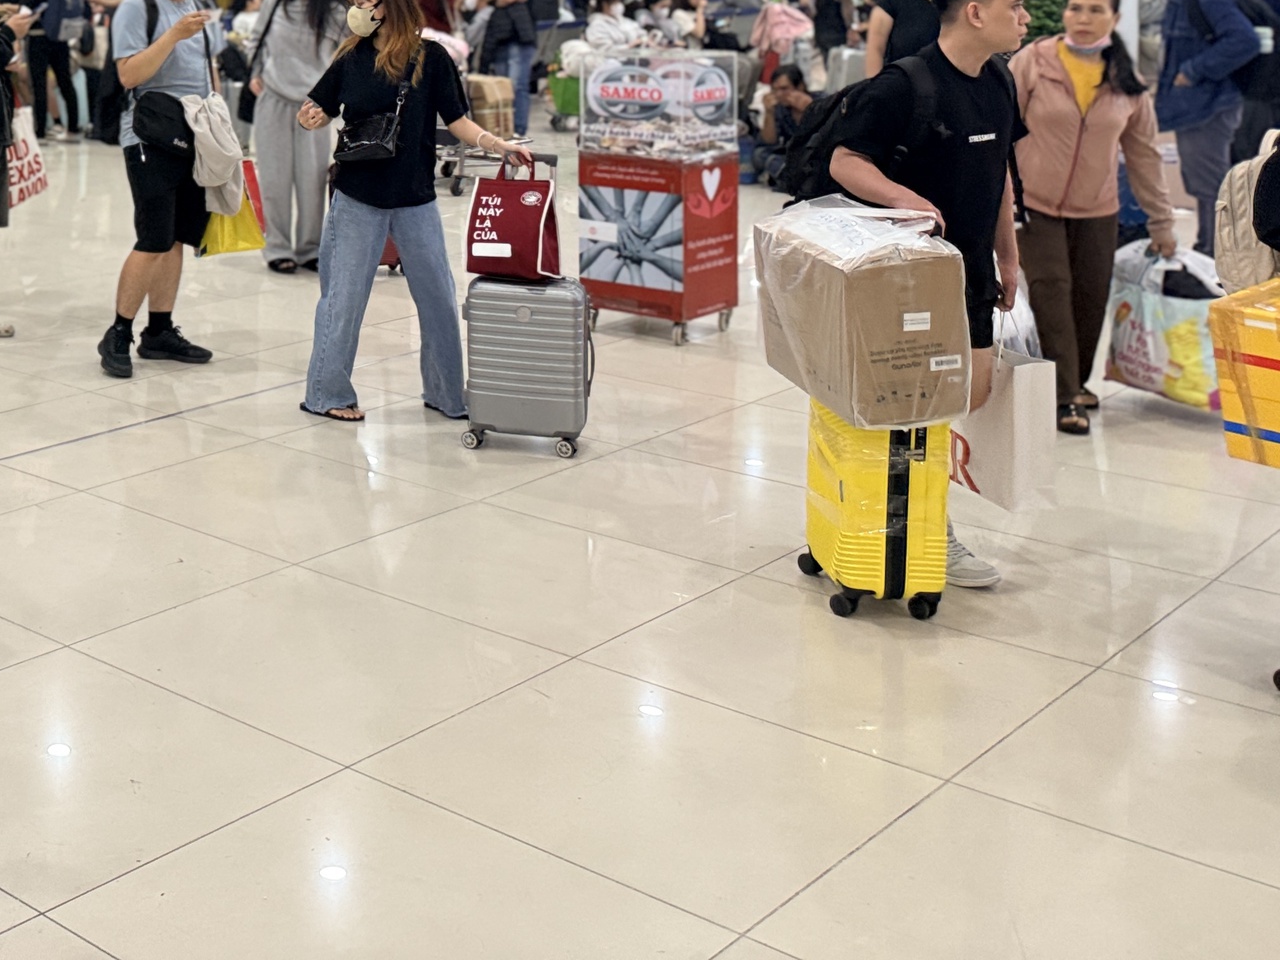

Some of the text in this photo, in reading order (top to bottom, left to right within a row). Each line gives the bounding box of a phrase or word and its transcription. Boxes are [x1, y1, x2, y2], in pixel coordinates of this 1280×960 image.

[600, 85, 663, 103] SAMCO
[692, 87, 727, 102] SAMCO
[8, 154, 42, 187] EXAS
[480, 194, 501, 205] TÚI
[477, 205, 504, 216] NÀY
[475, 216, 491, 228] LÀ
[473, 228, 498, 240] CỦA
